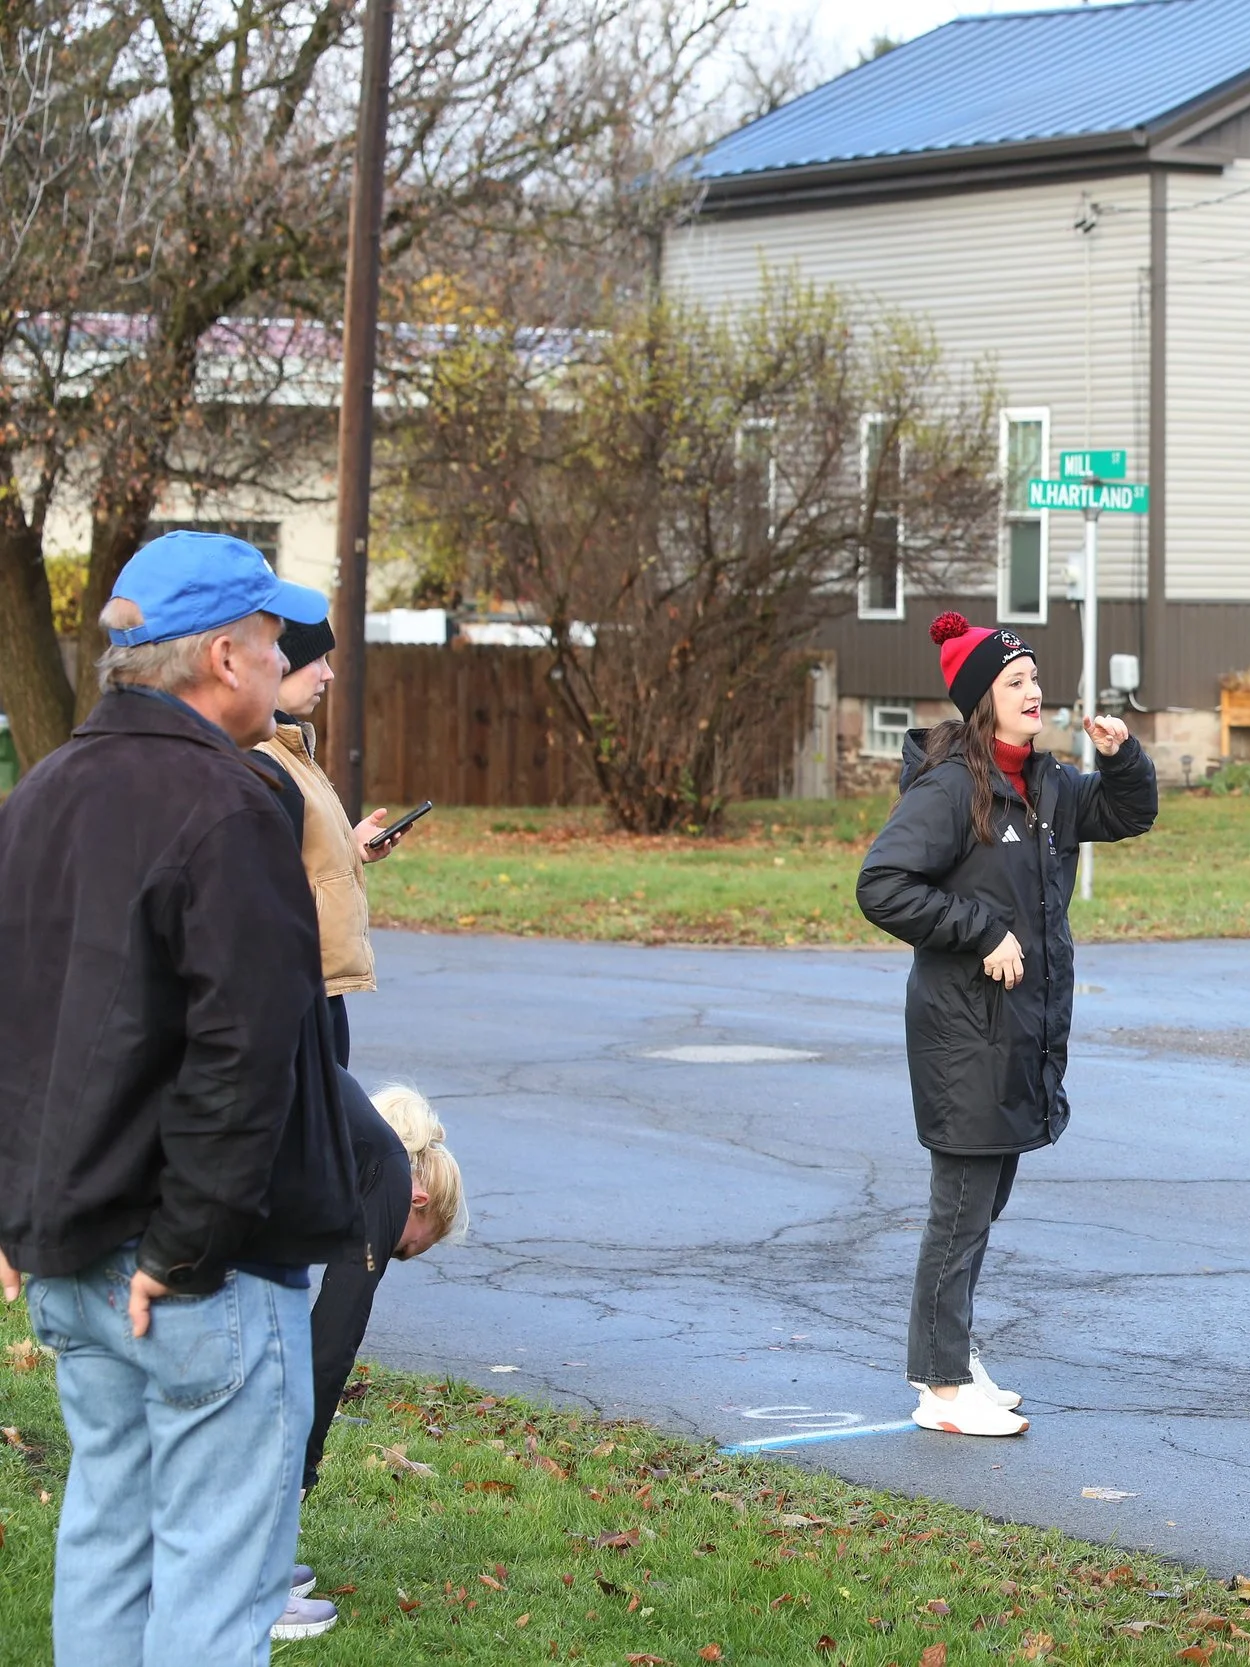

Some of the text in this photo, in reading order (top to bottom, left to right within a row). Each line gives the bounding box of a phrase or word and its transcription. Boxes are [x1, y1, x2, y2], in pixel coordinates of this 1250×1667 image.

[1065, 454, 1093, 476] MILL
[1031, 482, 1144, 509] N.HARTLAND ST
